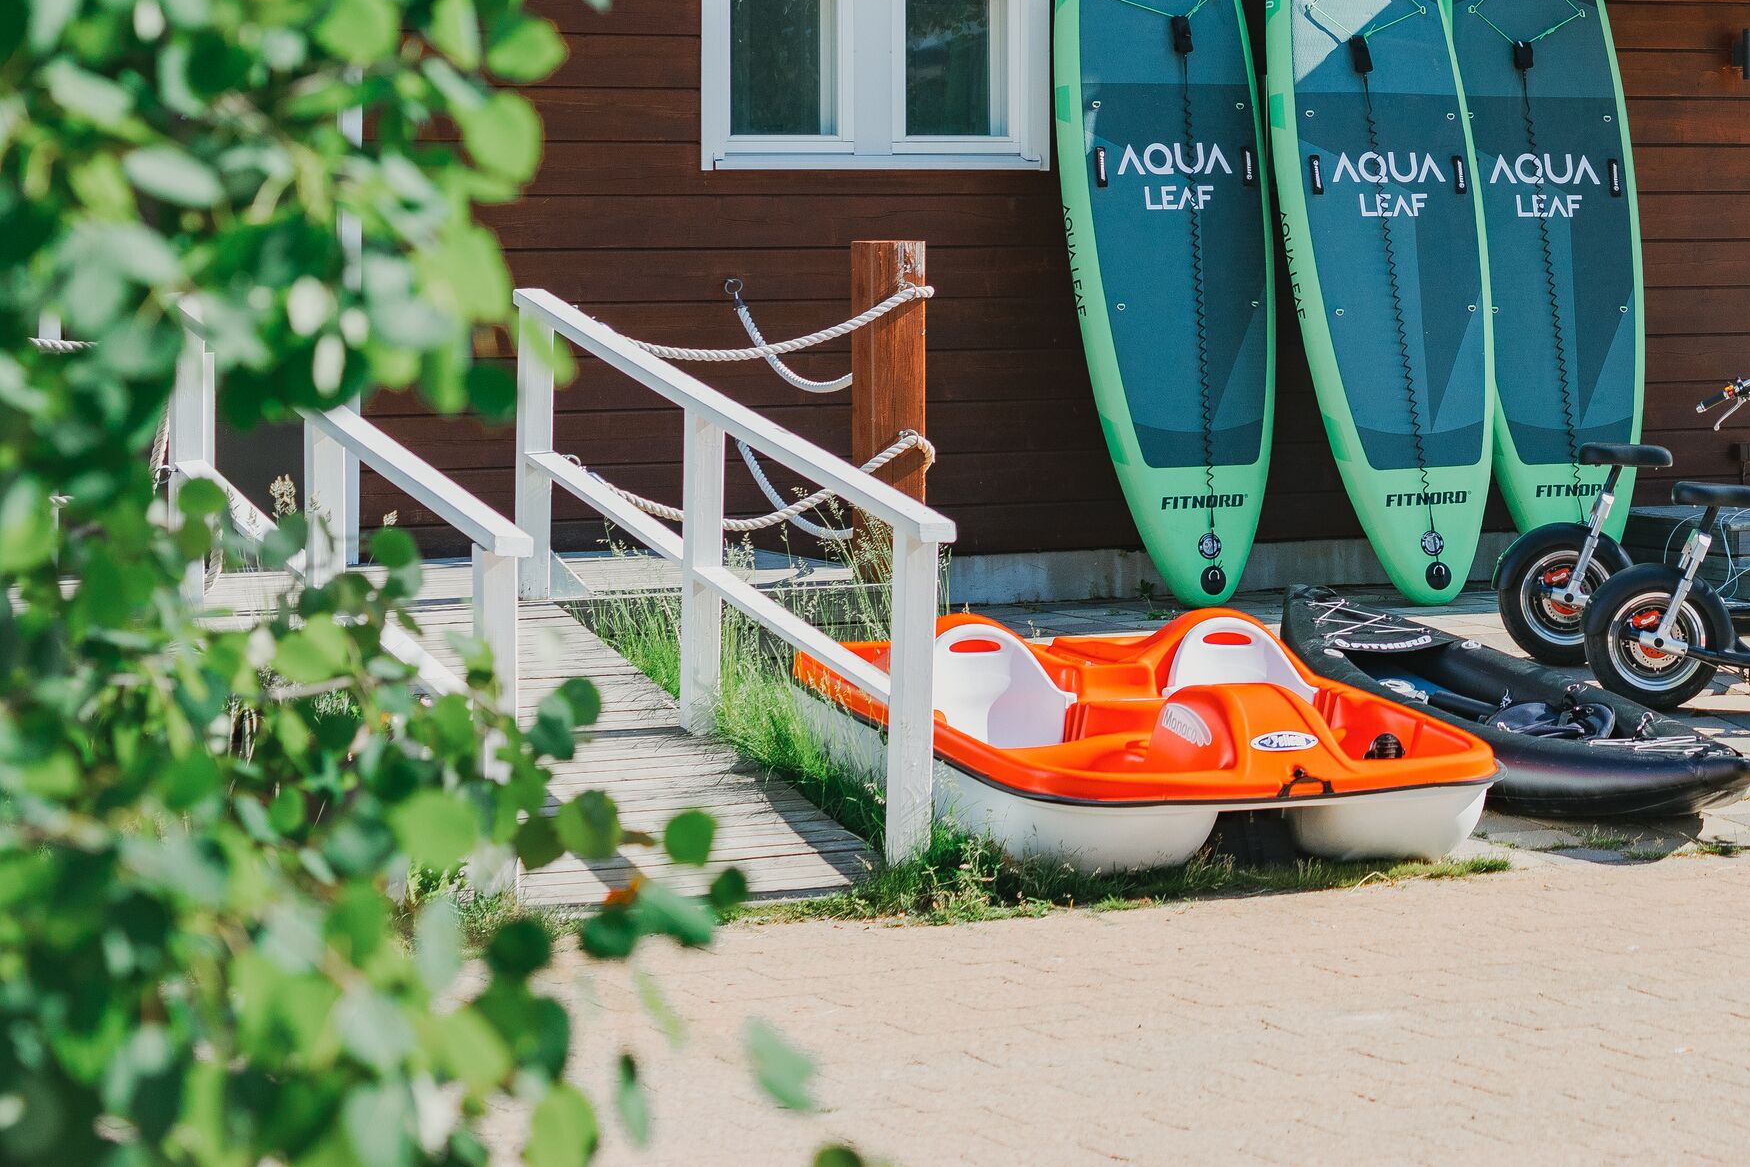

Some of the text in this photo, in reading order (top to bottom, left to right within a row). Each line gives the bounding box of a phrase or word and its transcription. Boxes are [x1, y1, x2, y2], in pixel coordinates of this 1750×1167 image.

[1117, 142, 1233, 175] AQUA
[1332, 151, 1446, 183] AQUA
[1489, 153, 1601, 185] AQUA
[1144, 185, 1215, 210] LEAF
[1359, 193, 1428, 217] LEAF
[1515, 194, 1583, 218] LEAF
[1161, 494, 1244, 510] FITNORD
[1385, 490, 1467, 507] FITNORD
[1536, 484, 1608, 498] FITNOR
[1350, 635, 1432, 651] FITNORD
[1163, 708, 1198, 743] Monaco
